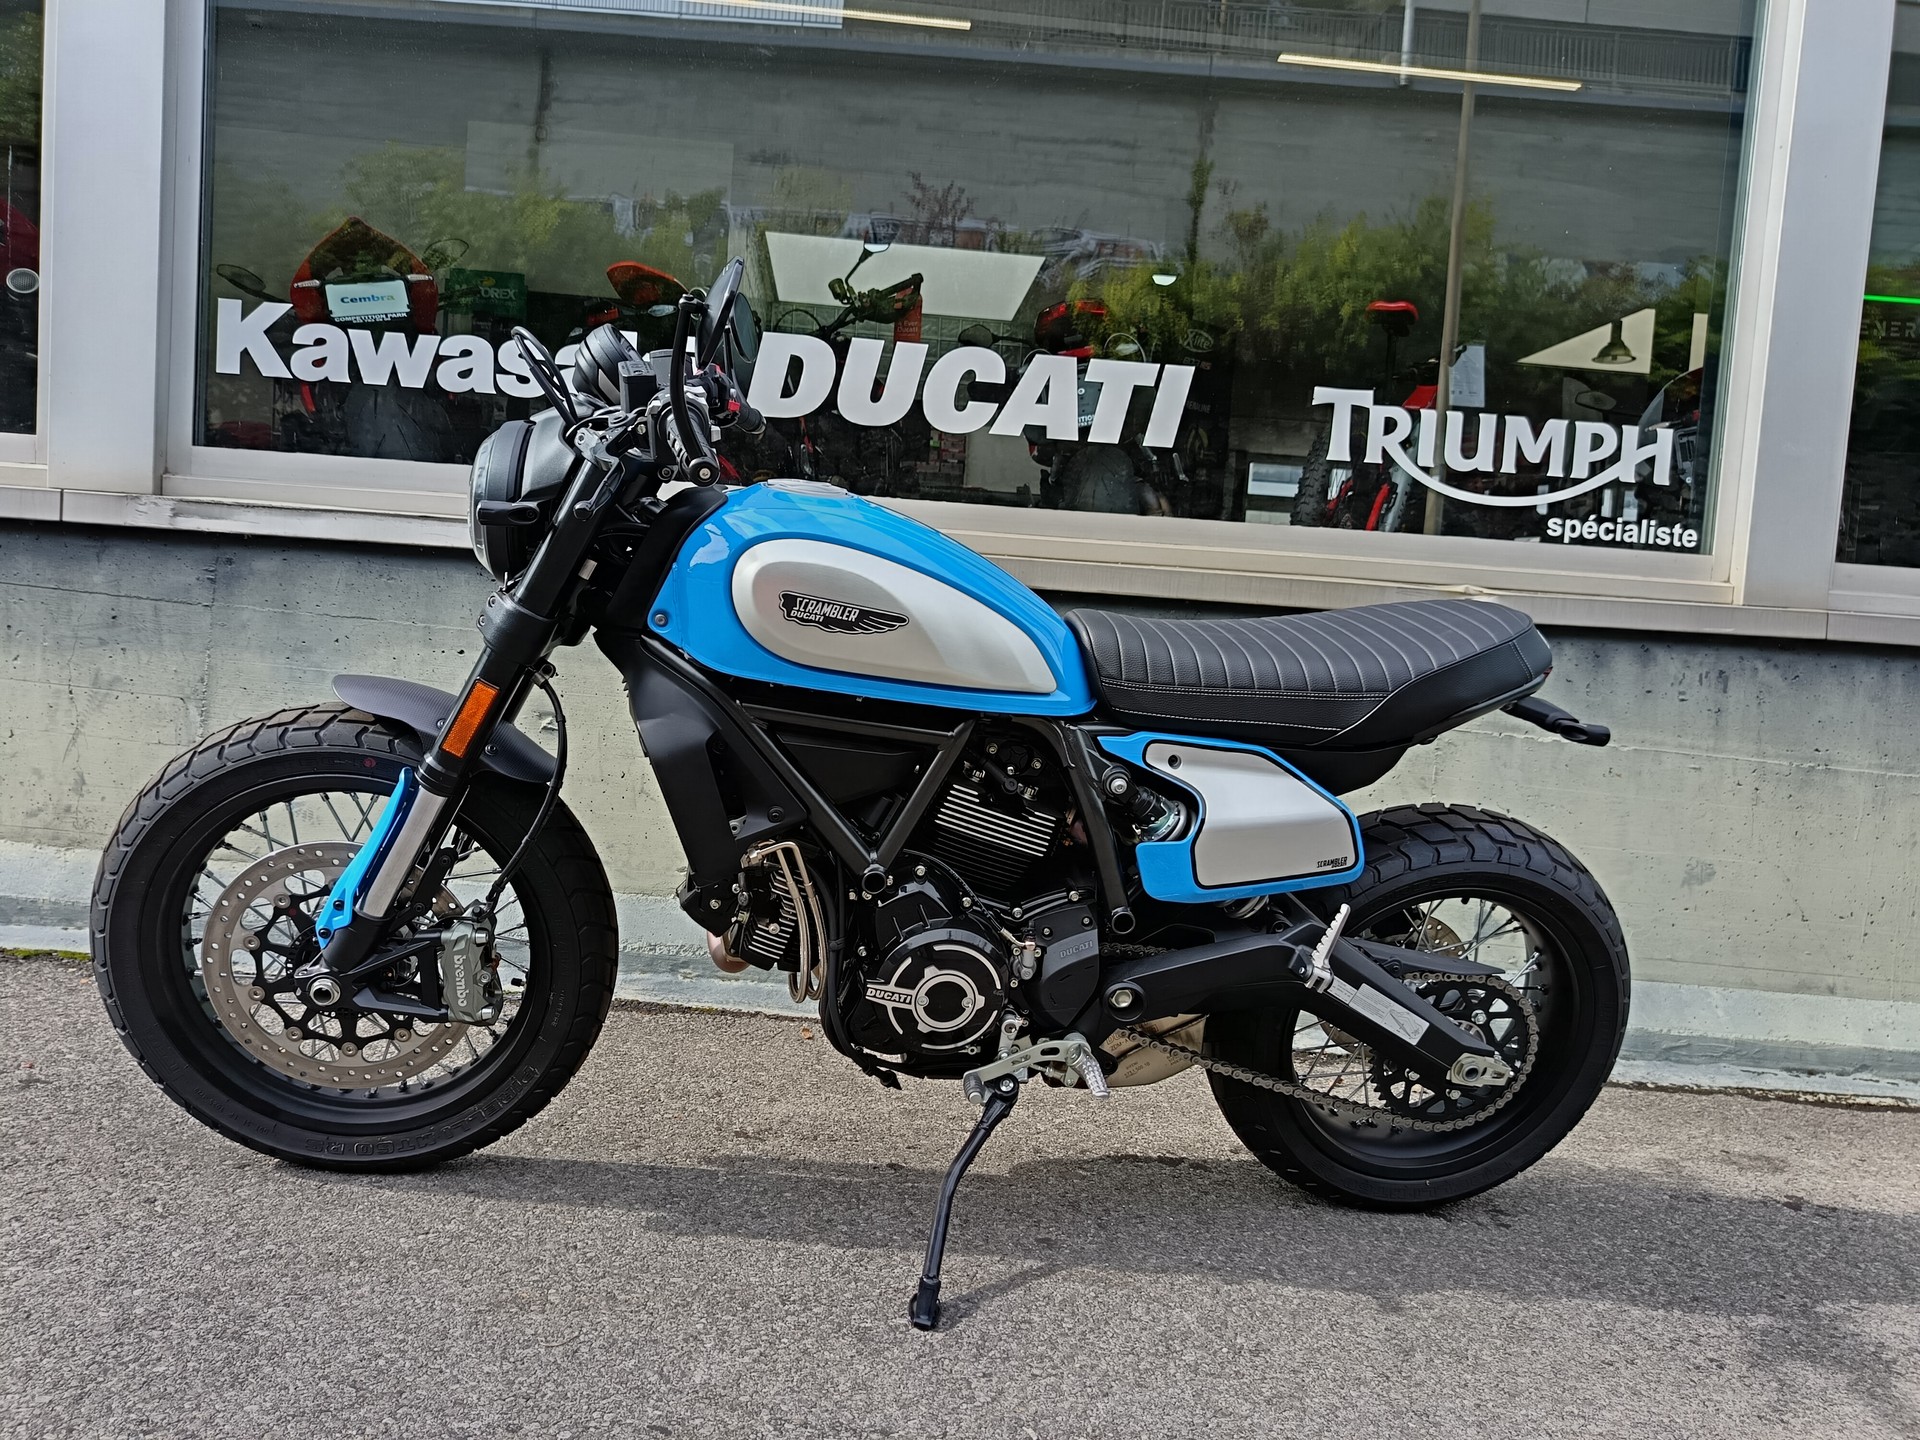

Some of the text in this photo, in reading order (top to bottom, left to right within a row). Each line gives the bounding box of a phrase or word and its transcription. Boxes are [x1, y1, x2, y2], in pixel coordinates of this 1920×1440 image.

[340, 294, 396, 304] Cembra
[334, 314, 386, 323] COMPETITION
[387, 312, 408, 320] PARK
[215, 297, 697, 405] Kawas
[746, 331, 1196, 449] DUCATI
[1312, 386, 1675, 506] TRIUMPH
[1546, 513, 1699, 549] spécialiste
[790, 611, 825, 622] DUCATI
[793, 598, 860, 622] SCRAMBLER
[1317, 856, 1348, 868] SCRAMBLER
[1060, 940, 1093, 958] DUCATI
[453, 954, 470, 1007] brembo
[866, 988, 911, 1003] DUCATI
[440, 1065, 540, 1139] PIRELLI
